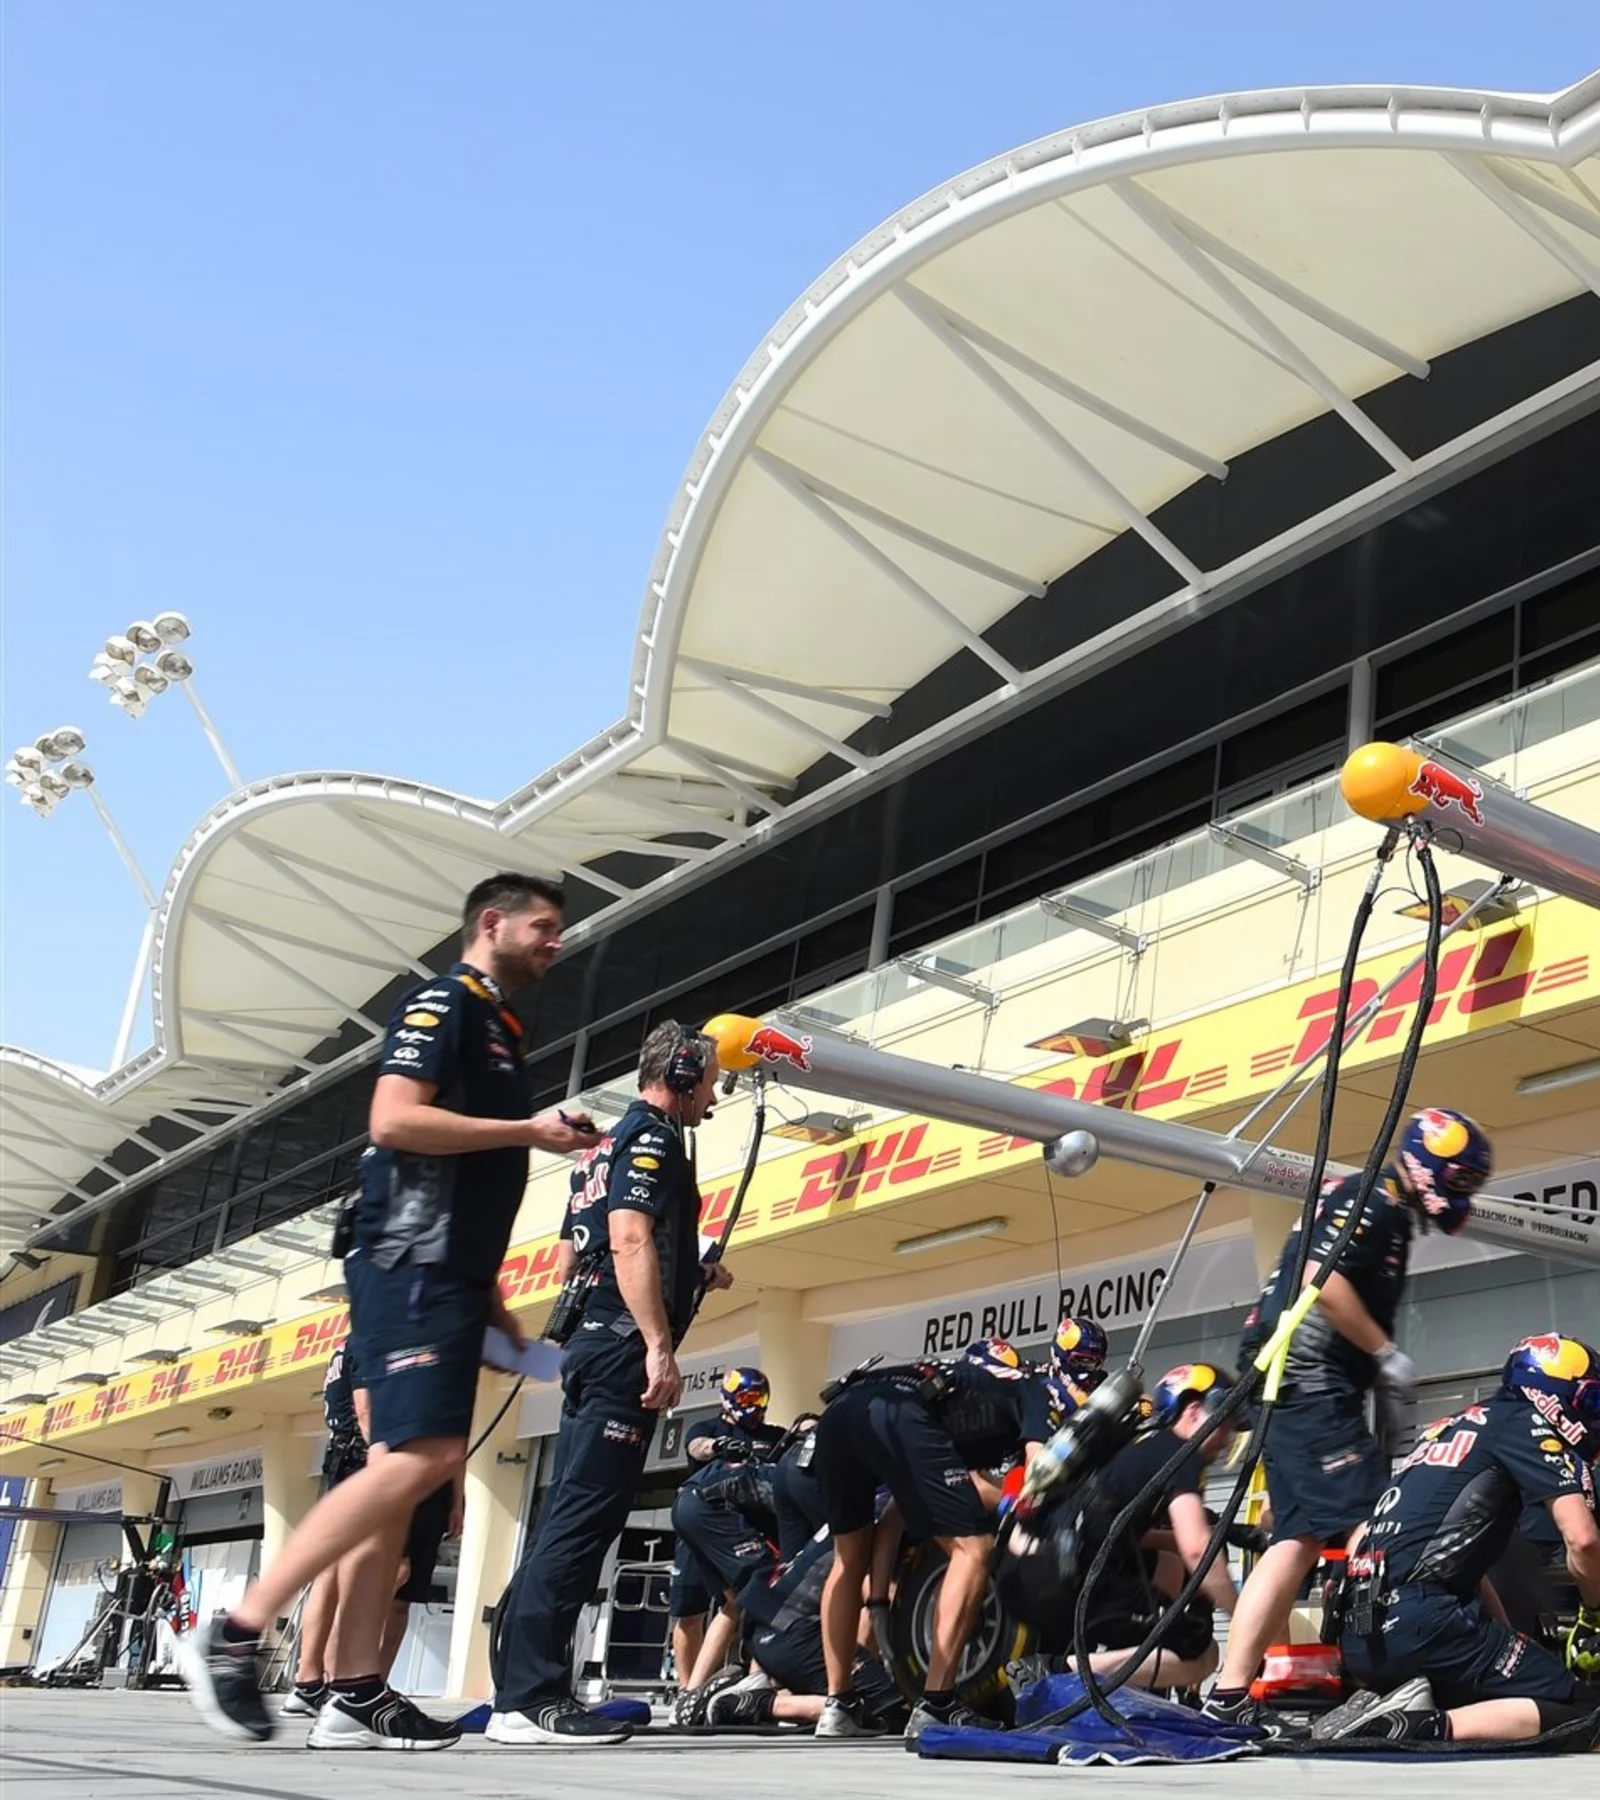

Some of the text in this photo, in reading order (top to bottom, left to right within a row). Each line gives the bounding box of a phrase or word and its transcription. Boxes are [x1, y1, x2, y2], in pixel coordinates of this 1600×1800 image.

[1290, 928, 1537, 1066] DHL
[793, 1122, 934, 1214] DHL
[1263, 1175, 1309, 1192] RACI
[498, 1244, 562, 1300] DH
[924, 1268, 1167, 1354] RED BULL RACING
[213, 1337, 273, 1384] DHL
[90, 1383, 130, 1421] DHL
[147, 1363, 192, 1404] DHL
[41, 1400, 75, 1435] DHL
[666, 1428, 676, 1450] 8
[190, 1463, 231, 1491] WILLIAMS
